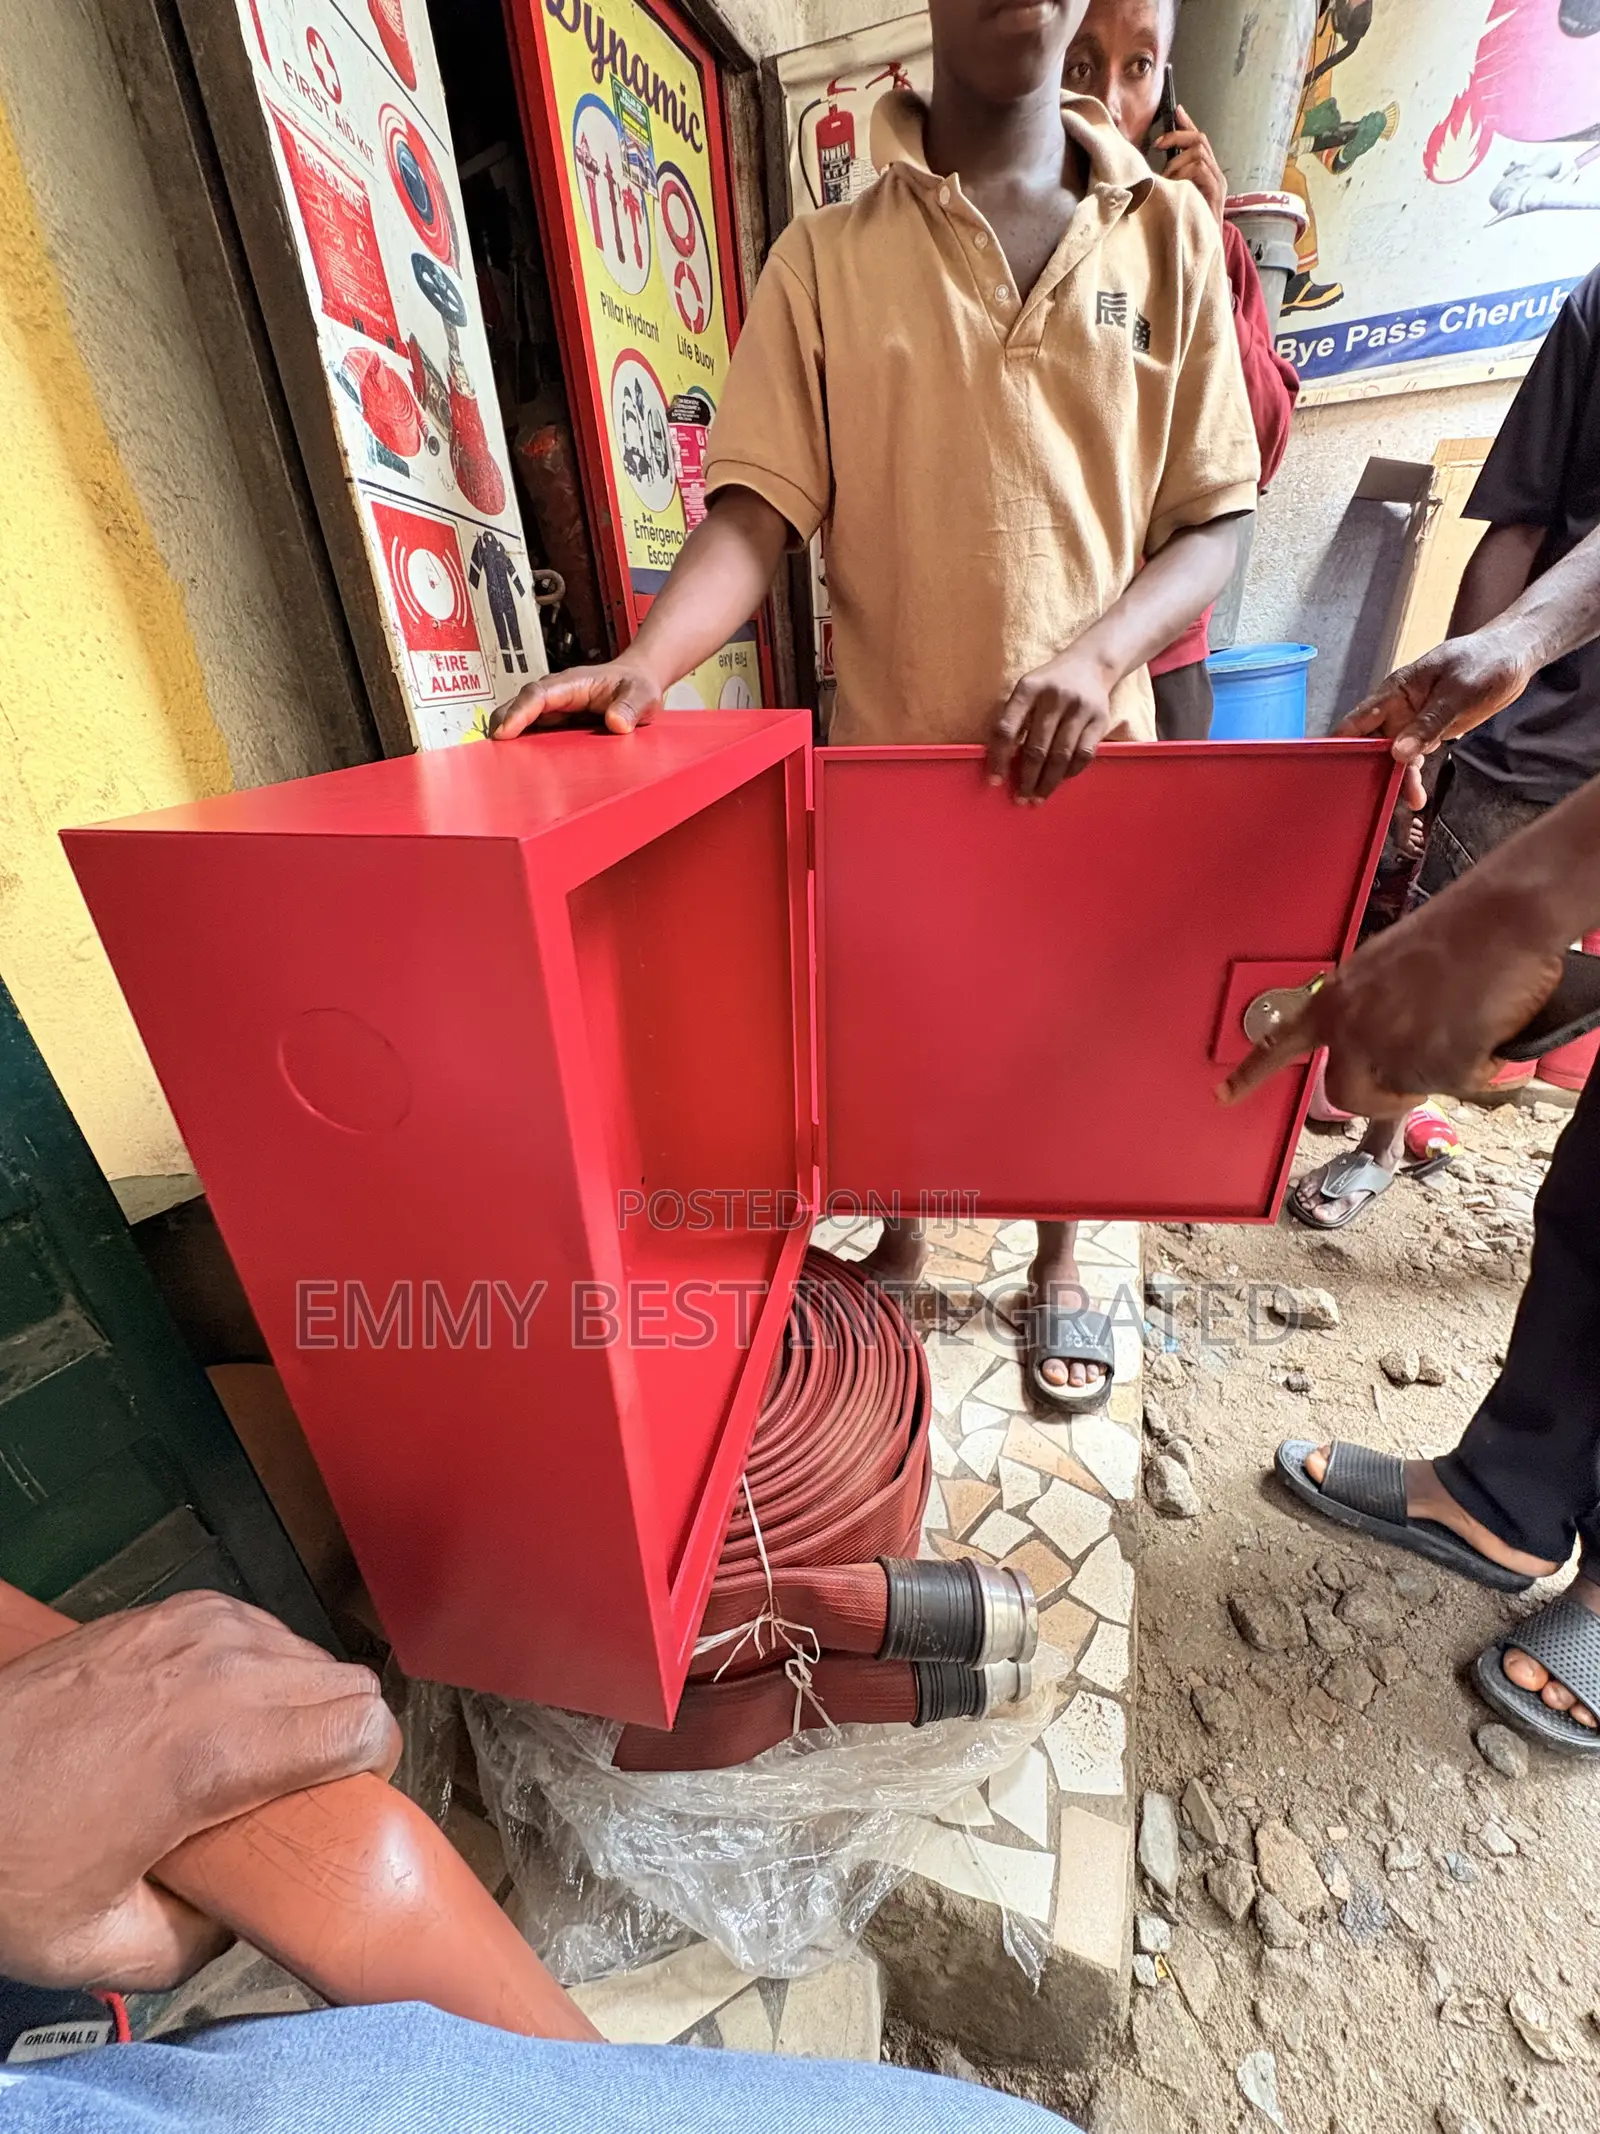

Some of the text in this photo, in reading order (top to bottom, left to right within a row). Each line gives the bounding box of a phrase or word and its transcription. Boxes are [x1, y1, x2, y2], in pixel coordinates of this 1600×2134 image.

[282, 59, 375, 167] FIRST AID KIT
[600, 290, 660, 344] Pillar Hydrant
[677, 333, 715, 377] Life Buoy
[1276, 338, 1335, 367] Bye
[1345, 317, 1428, 353] Pass
[431, 674, 481, 693] ALARM
[435, 655, 469, 672] FIRE
[24, 2030, 84, 2046] ORIGINAL
